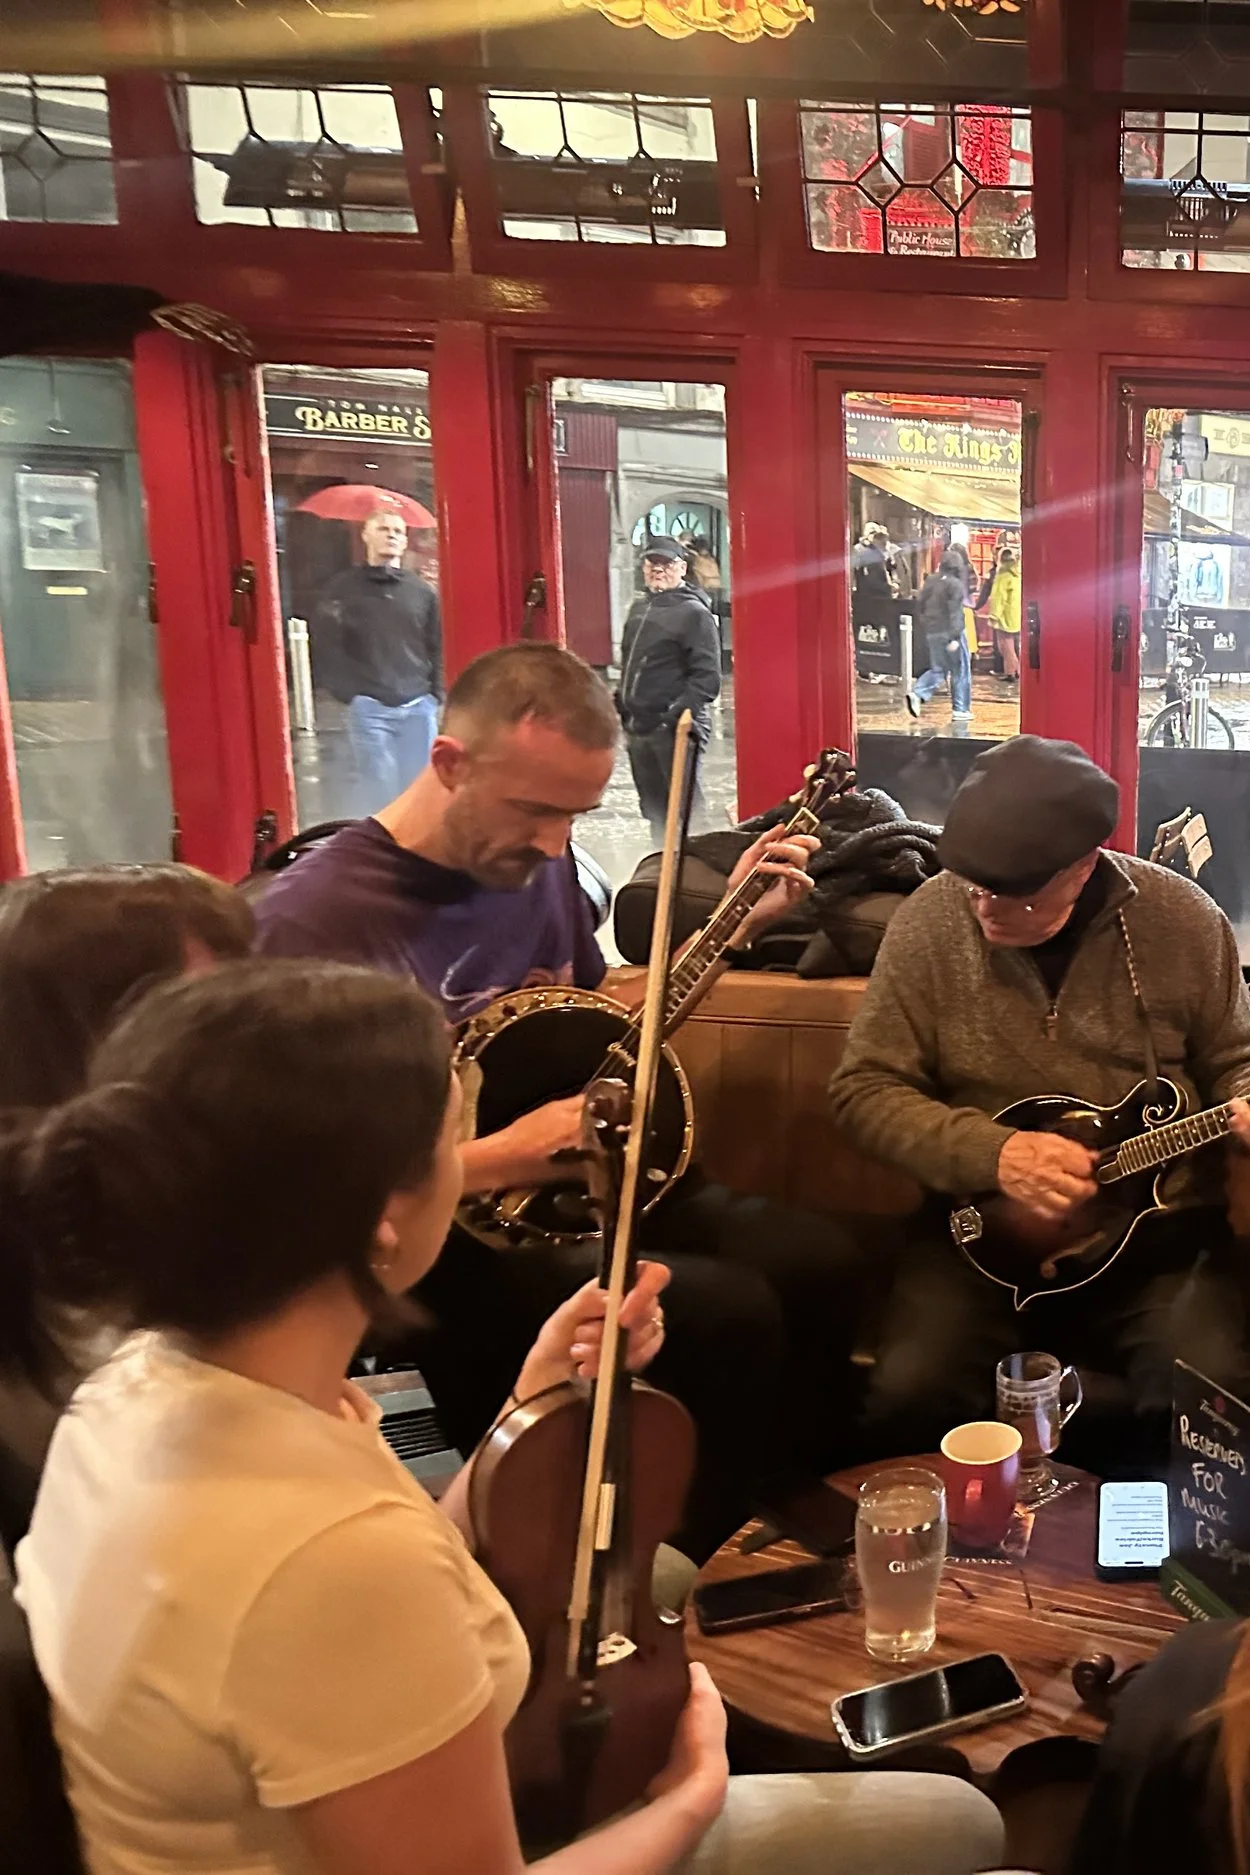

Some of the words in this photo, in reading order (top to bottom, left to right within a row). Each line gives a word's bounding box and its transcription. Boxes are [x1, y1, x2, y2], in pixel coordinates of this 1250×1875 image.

[898, 426, 938, 454] The
[1178, 1413, 1248, 1477] RESERVED
[1191, 1462, 1228, 1500] FOR
